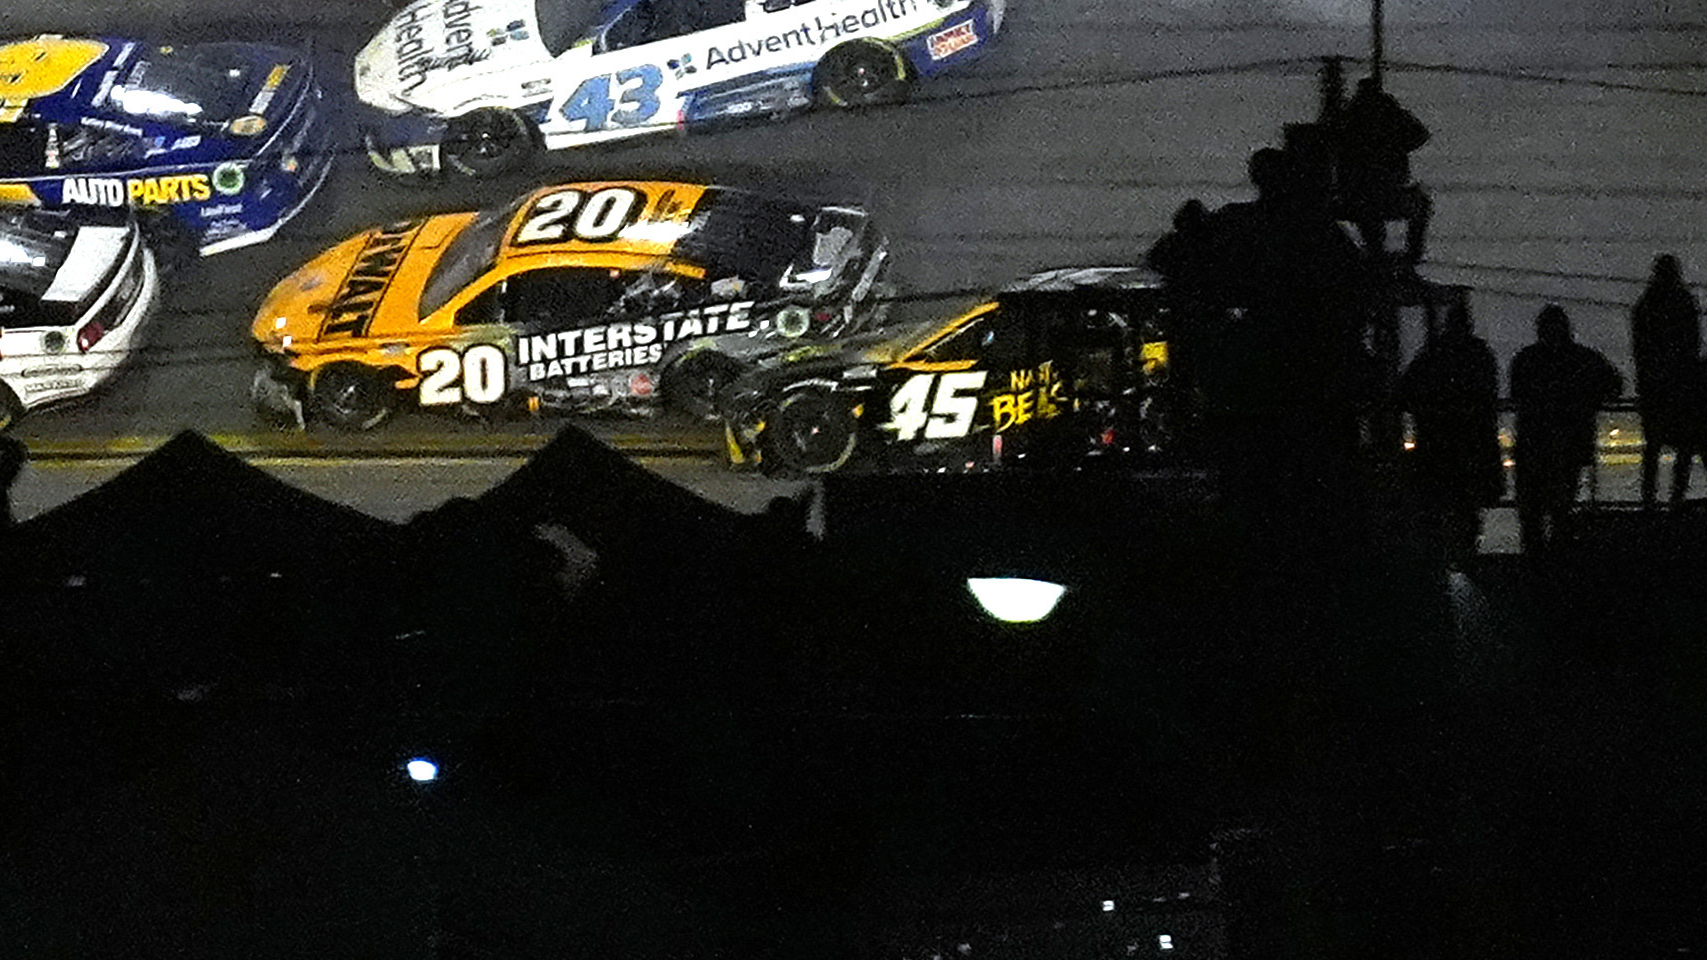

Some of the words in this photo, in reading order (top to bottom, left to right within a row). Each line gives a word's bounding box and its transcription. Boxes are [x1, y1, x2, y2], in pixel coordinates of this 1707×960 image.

[558, 63, 664, 133] 43
[62, 177, 125, 207] AUTO
[126, 174, 212, 205] PARTS
[519, 188, 636, 242] 20
[517, 300, 755, 365] INTERSTATE
[529, 342, 663, 382] BATTERIES
[419, 346, 508, 405] 20
[886, 370, 988, 442] 45
